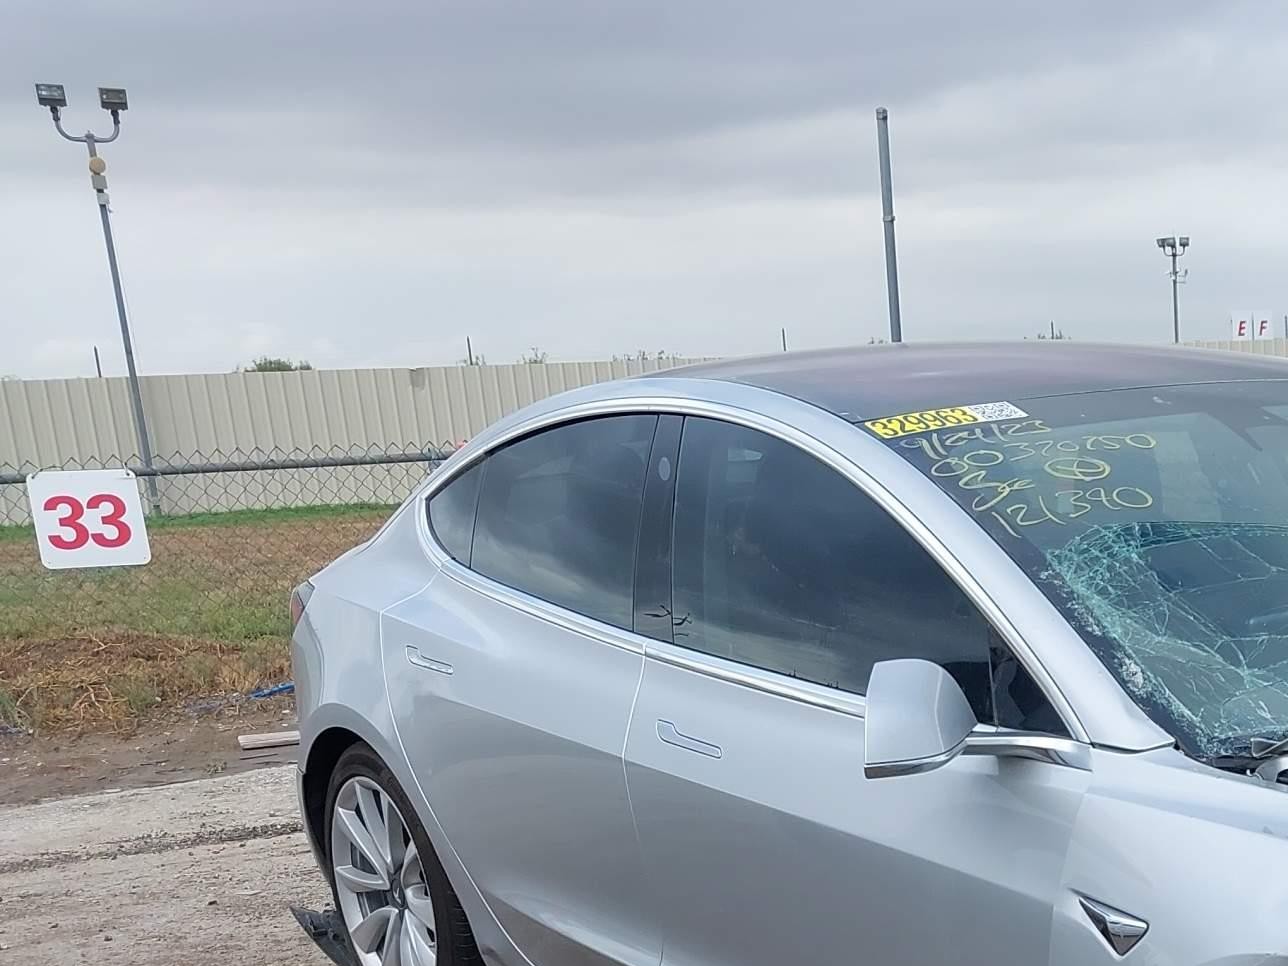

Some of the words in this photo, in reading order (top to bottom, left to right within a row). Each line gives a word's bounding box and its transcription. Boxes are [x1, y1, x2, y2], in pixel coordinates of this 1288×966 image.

[1237, 320, 1247, 337] E
[1259, 320, 1268, 337] F
[870, 408, 979, 438] 329963
[43, 493, 132, 550] 33
